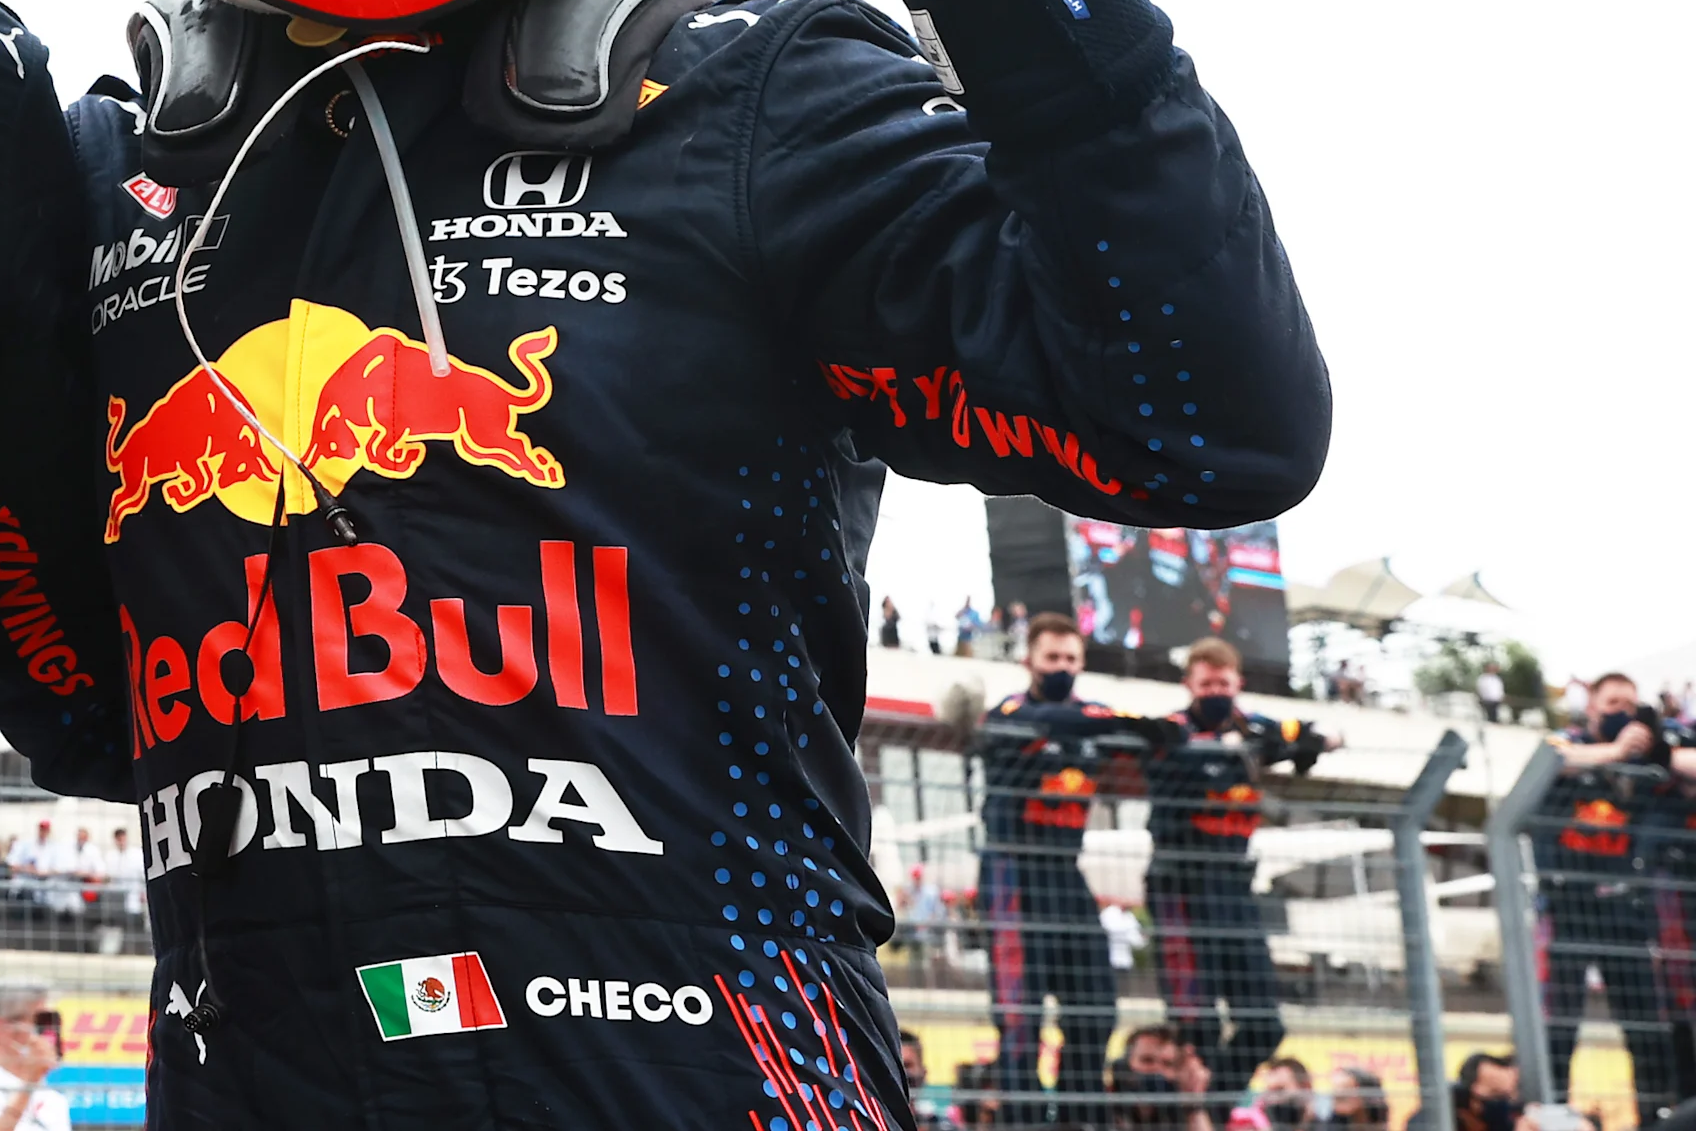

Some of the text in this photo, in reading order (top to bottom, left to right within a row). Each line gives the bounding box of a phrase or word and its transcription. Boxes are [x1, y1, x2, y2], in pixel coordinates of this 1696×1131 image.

[88, 222, 183, 291] Mobil
[428, 211, 628, 241] HONDA
[92, 264, 211, 335] ORACLE
[482, 257, 627, 304] Tezos
[308, 540, 640, 719] Bull
[143, 750, 665, 881] HONDA
[525, 976, 716, 1027] CHECO
